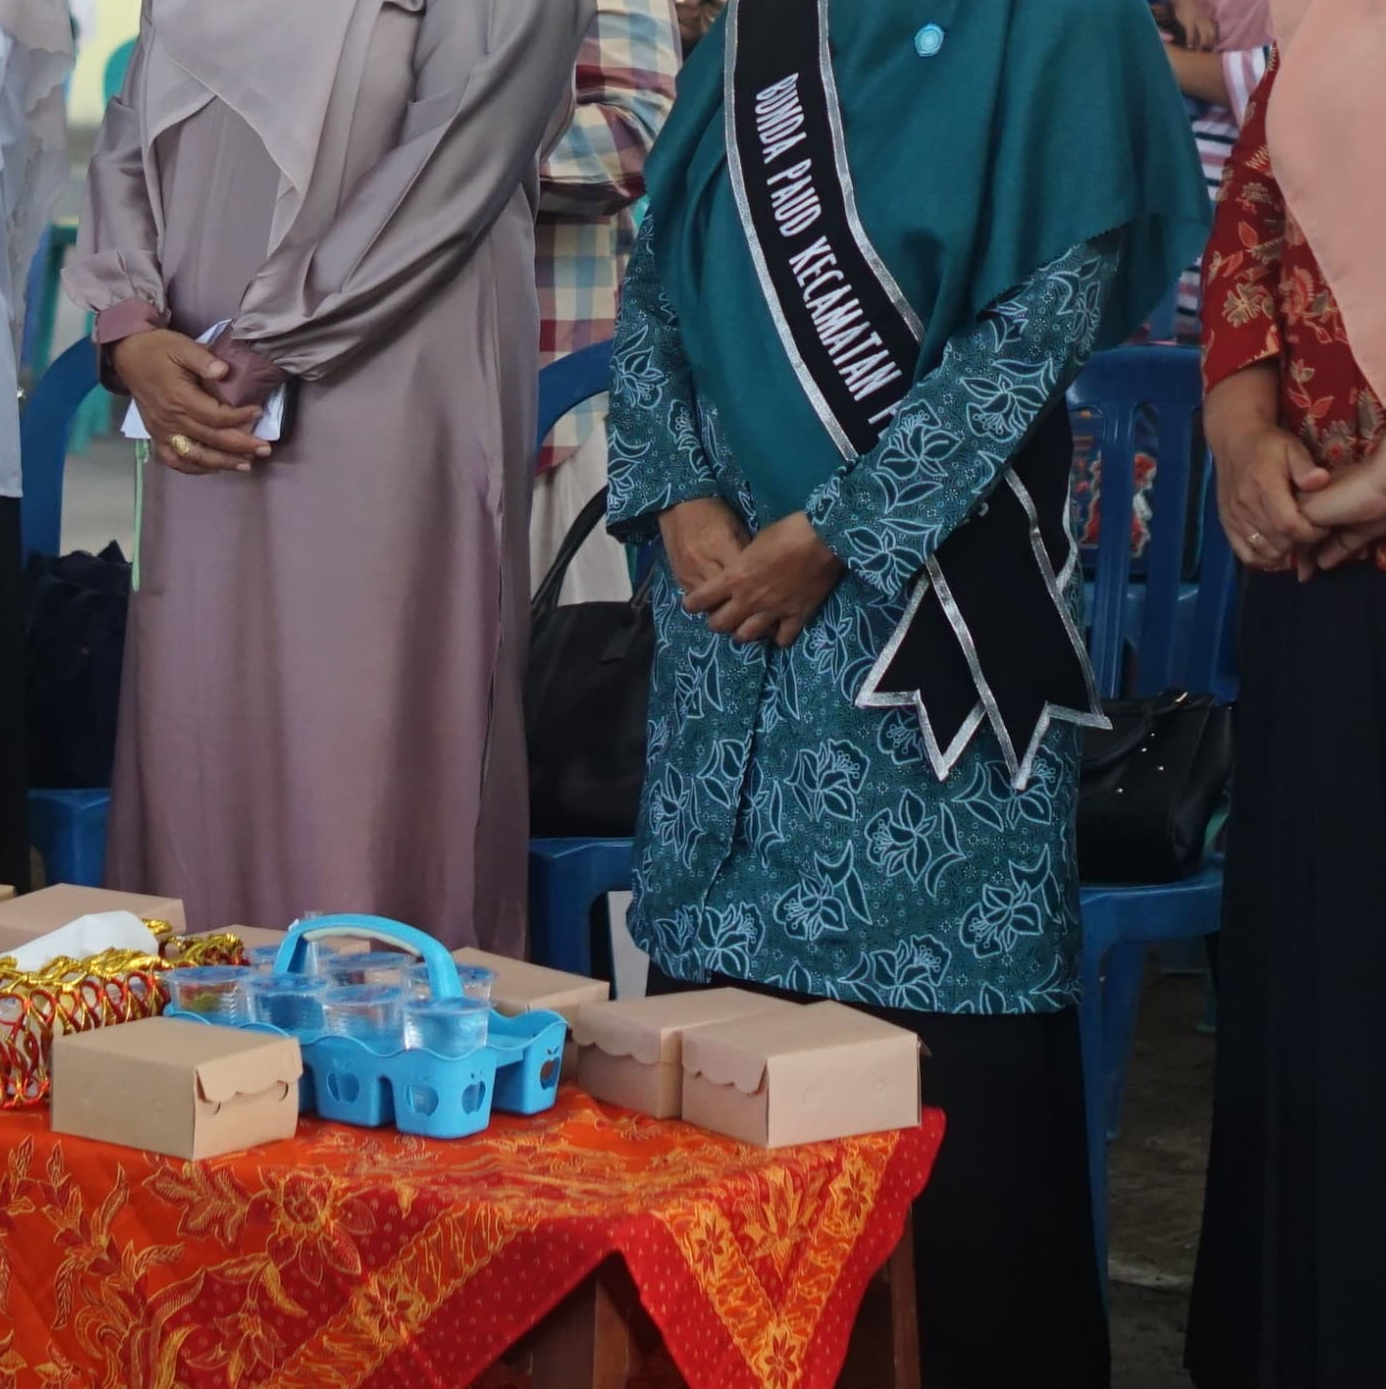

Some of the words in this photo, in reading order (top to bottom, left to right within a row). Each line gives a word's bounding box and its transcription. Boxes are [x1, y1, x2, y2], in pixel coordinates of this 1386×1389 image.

[755, 72, 808, 165] BUNDA
[766, 157, 822, 238] PAUD
[788, 234, 904, 403] KECAMATAN
